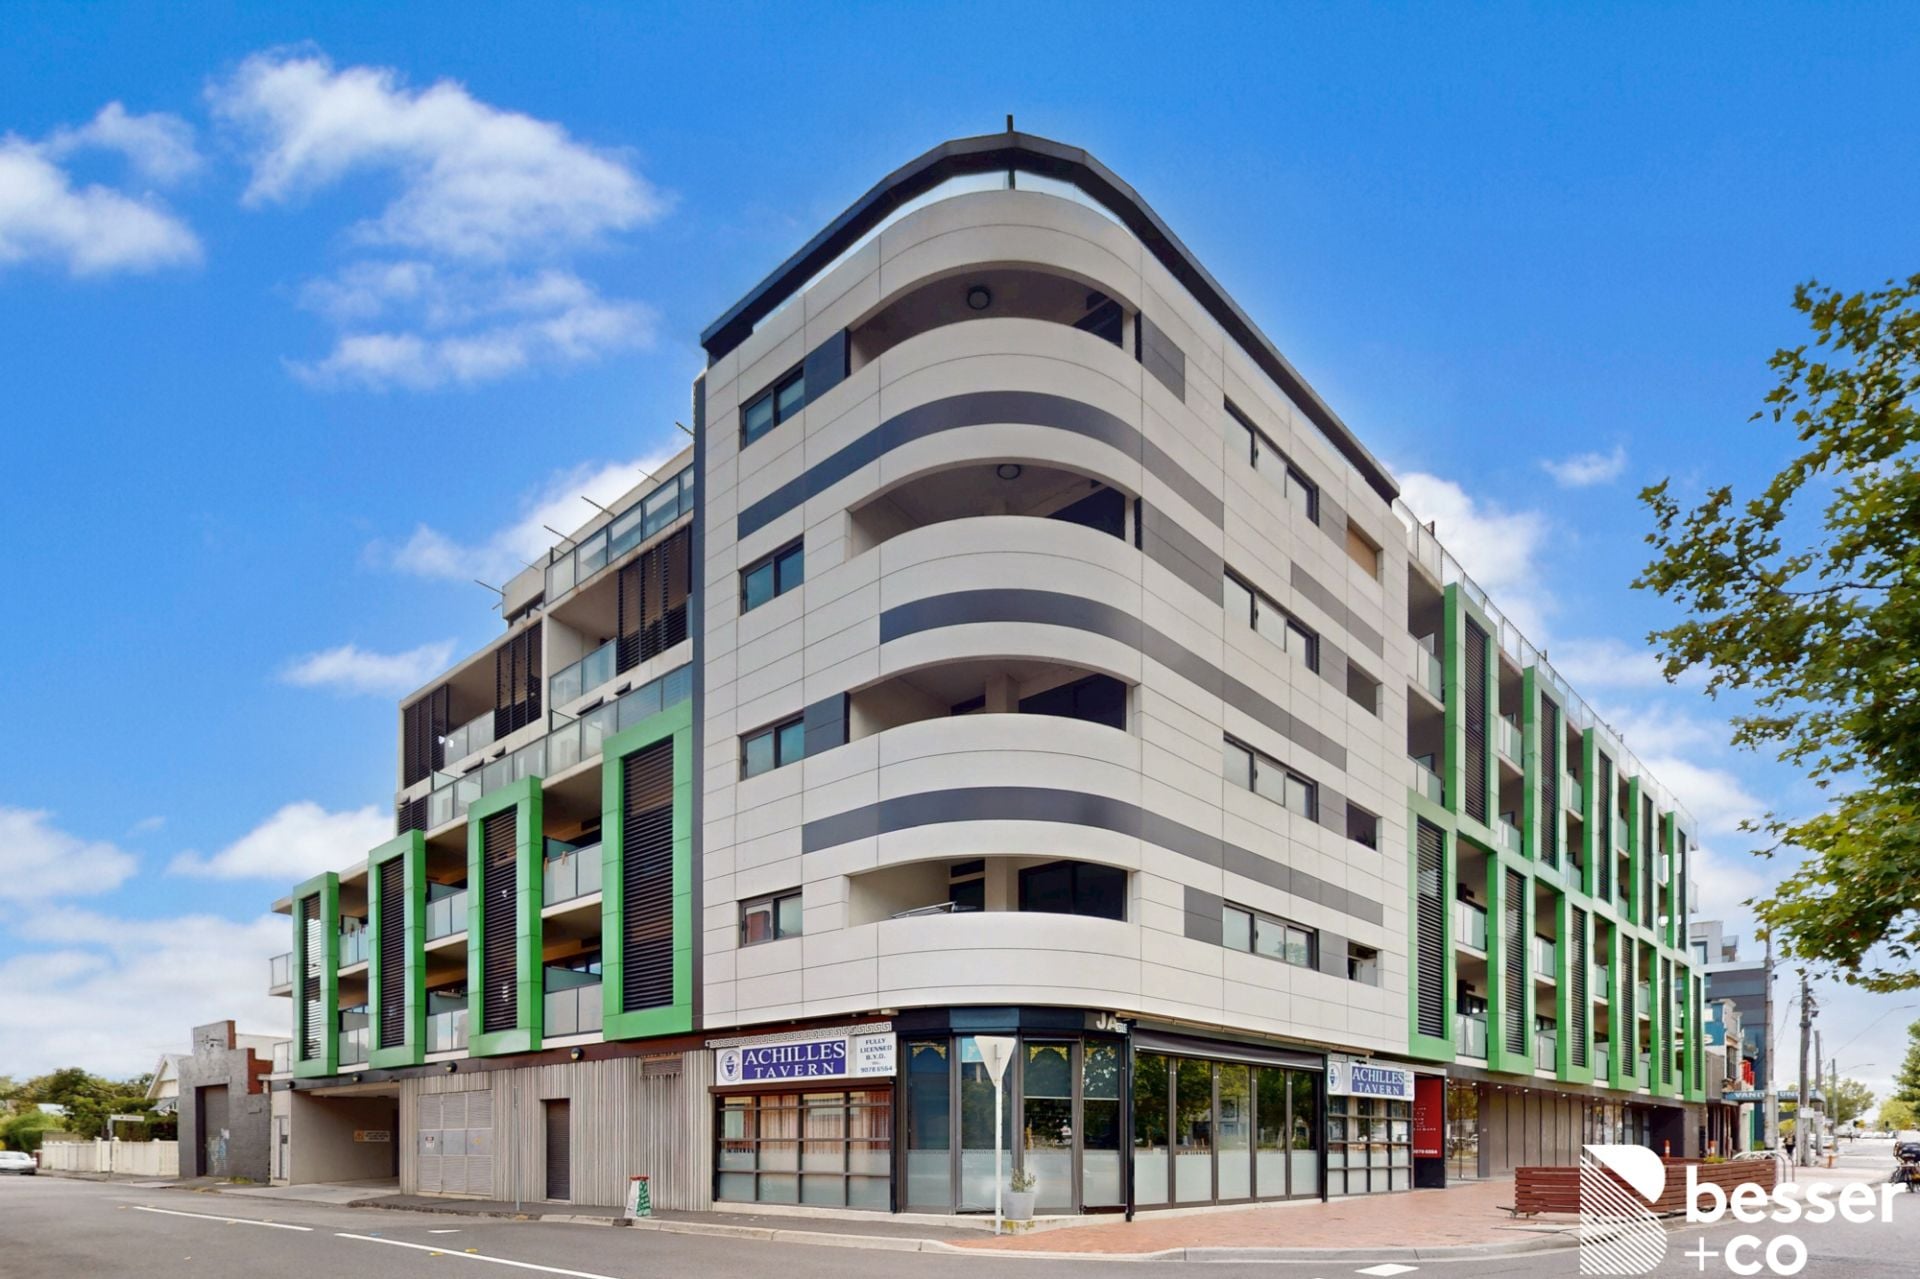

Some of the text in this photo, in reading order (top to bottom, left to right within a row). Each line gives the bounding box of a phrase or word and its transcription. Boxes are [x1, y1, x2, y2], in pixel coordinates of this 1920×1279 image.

[744, 1042, 845, 1066] ACHILLES
[754, 1062, 835, 1079] TAVERN
[1352, 1068, 1404, 1085] ACHILLES
[1358, 1082, 1399, 1095] TAVERN
